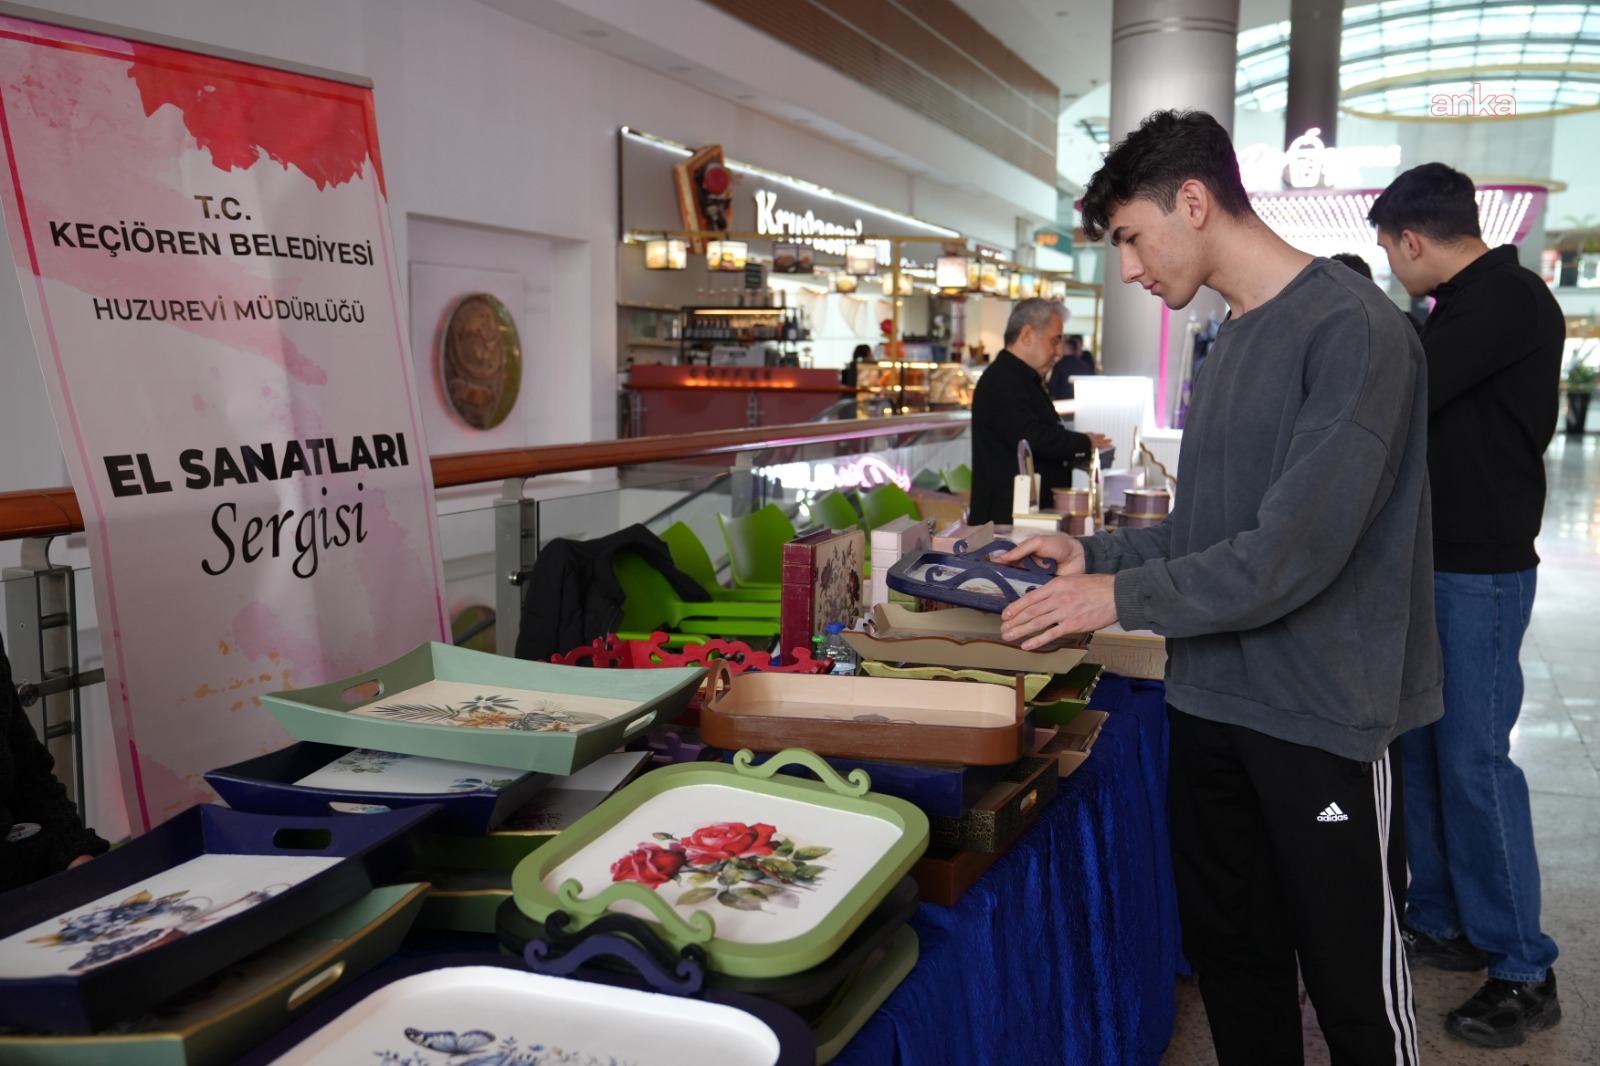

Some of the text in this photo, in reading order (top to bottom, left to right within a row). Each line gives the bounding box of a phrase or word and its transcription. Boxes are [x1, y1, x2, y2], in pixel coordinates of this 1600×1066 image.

[194, 194, 252, 221] T.C.
[49, 220, 375, 266] KEÇİÖREN BELEDİYESİ
[92, 295, 366, 323] HUZUREVİ MÜDÜRLÜĞÜ
[689, 368, 772, 381] COFFEE
[102, 432, 410, 498] EL SANATLARI
[201, 482, 368, 579] Sergisi
[1316, 813, 1348, 822] adidas
